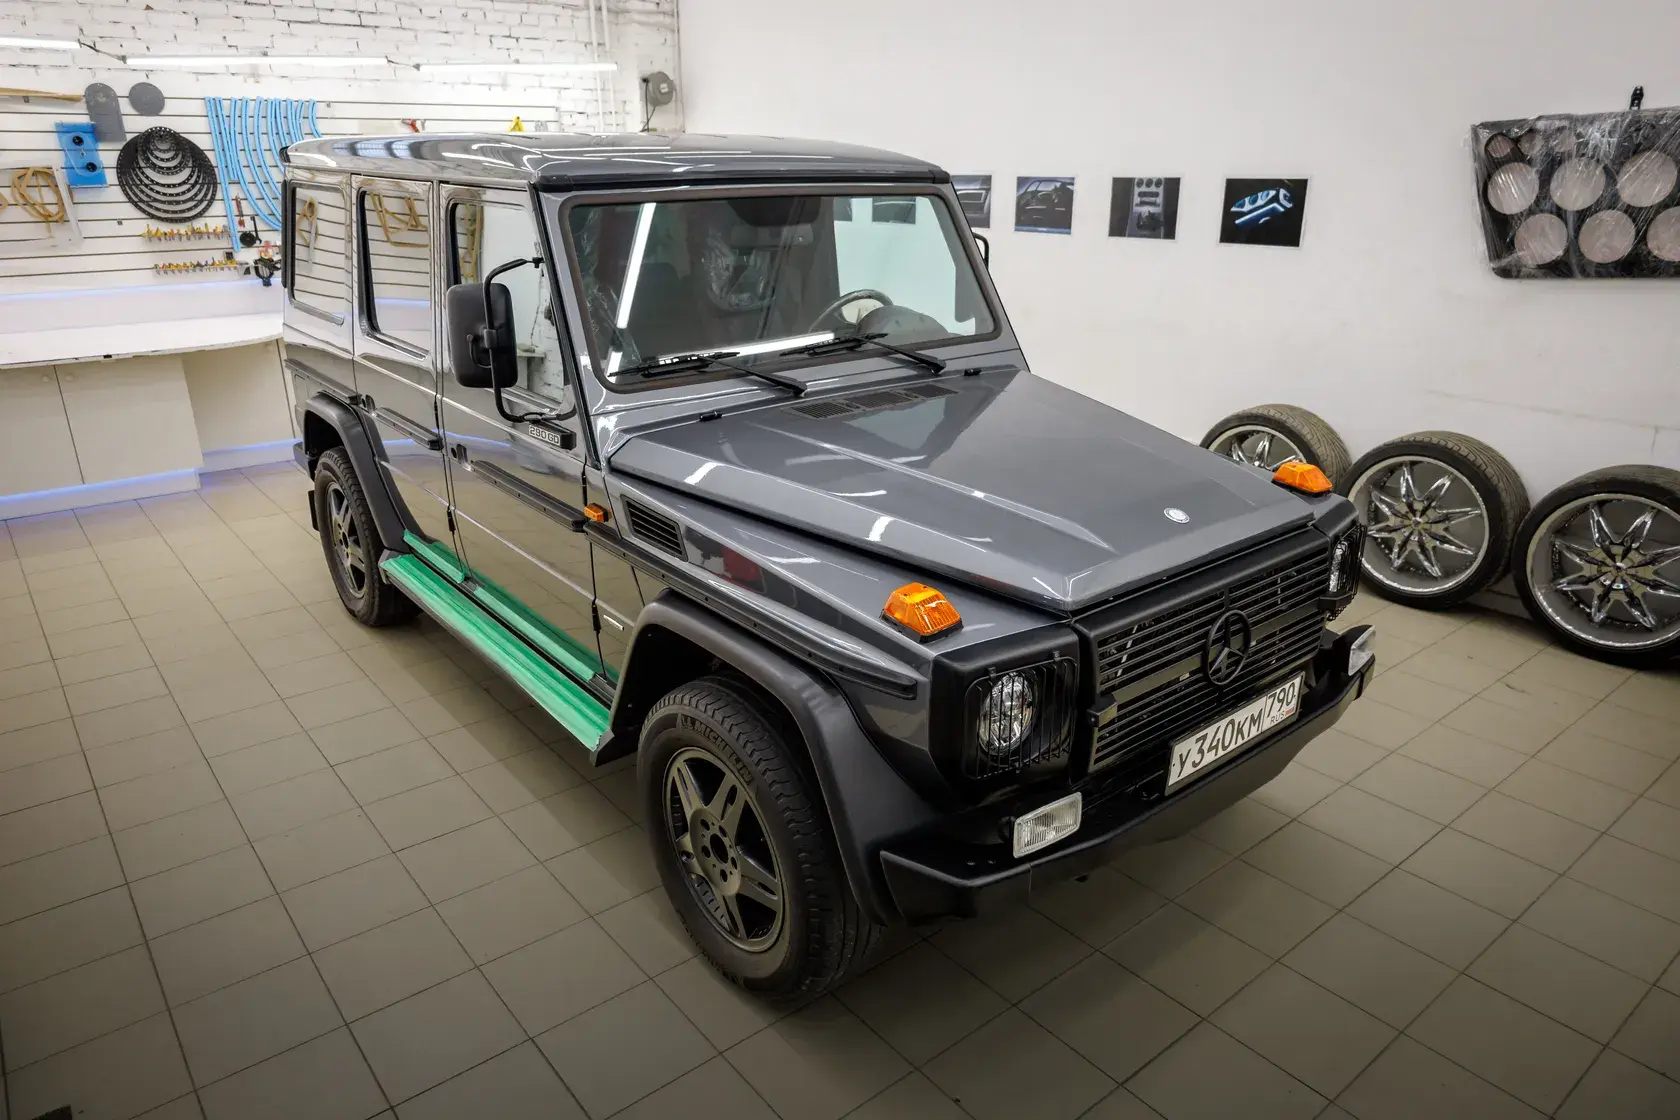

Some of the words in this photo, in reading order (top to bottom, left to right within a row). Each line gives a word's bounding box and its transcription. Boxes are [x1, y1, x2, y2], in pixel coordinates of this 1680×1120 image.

[529, 426, 547, 440] 290
[547, 433, 560, 445] GD
[1266, 682, 1295, 718] 790
[1270, 711, 1286, 726] RUS
